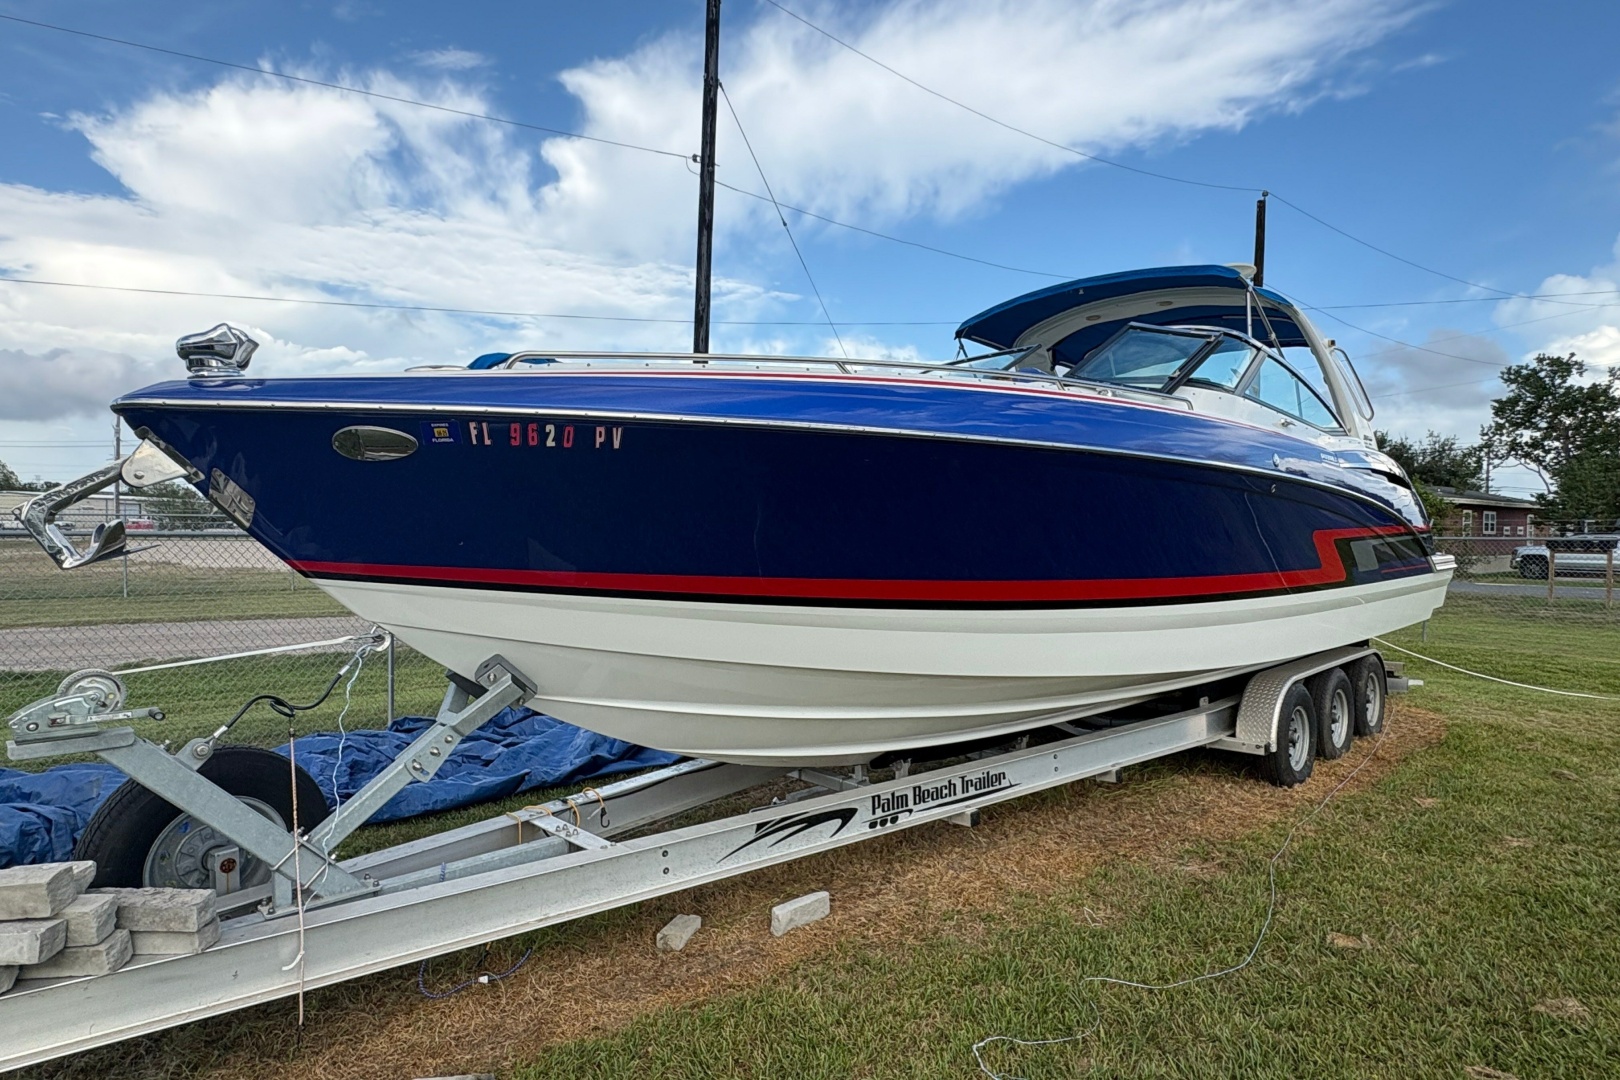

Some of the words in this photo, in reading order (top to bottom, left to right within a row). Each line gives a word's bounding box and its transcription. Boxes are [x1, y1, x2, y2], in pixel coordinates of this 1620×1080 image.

[469, 421, 492, 446] FL
[510, 422, 574, 448] 9620
[595, 426, 622, 449] PV
[871, 792, 909, 815] Palm
[912, 780, 957, 806] Beach
[959, 771, 1006, 795] Trailer
